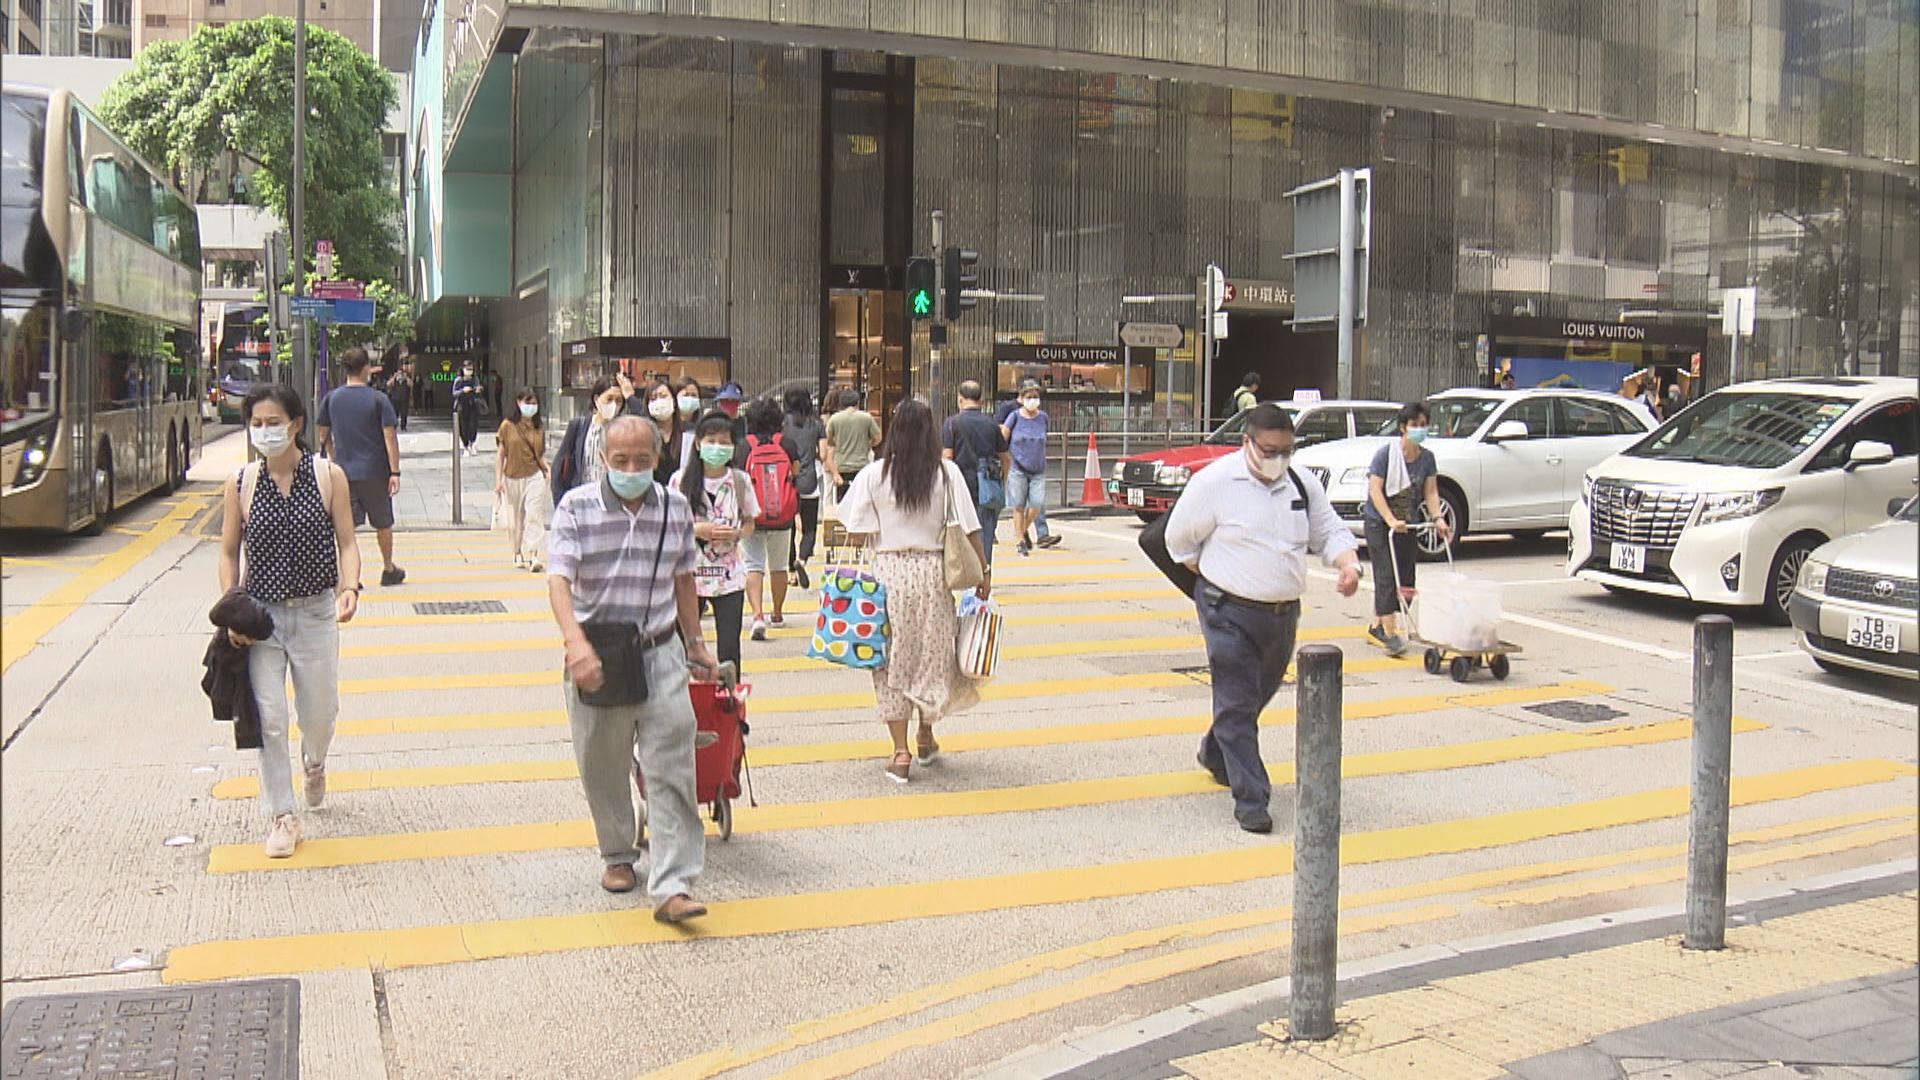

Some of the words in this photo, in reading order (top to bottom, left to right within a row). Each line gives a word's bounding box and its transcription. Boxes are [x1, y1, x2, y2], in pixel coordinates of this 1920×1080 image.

[1243, 286, 1288, 303] 中環站
[1562, 323, 1595, 337] LOUIS
[1599, 325, 1645, 339] VUITTON
[1036, 348, 1068, 359] LOUIS
[1071, 349, 1117, 360] VUITTON
[1621, 545, 1636, 558] VN
[1617, 556, 1636, 570] 184
[1864, 616, 1884, 633] TB
[1851, 629, 1895, 649] 3928
